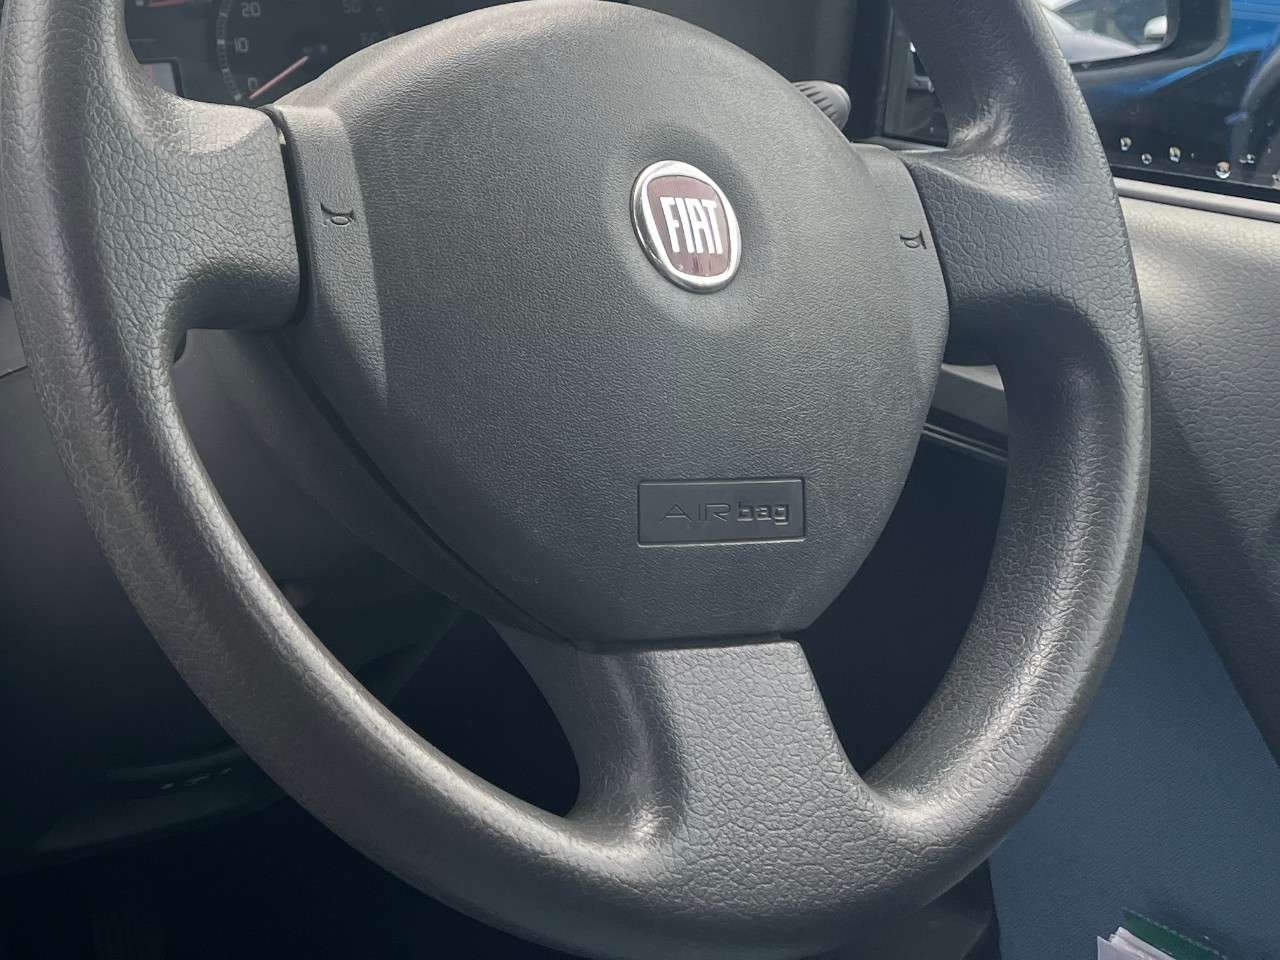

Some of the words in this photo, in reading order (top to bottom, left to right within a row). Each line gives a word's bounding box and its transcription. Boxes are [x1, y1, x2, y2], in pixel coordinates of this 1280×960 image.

[240, 0, 262, 17] 20
[232, 37, 249, 54] 10
[659, 196, 724, 256] FIAT
